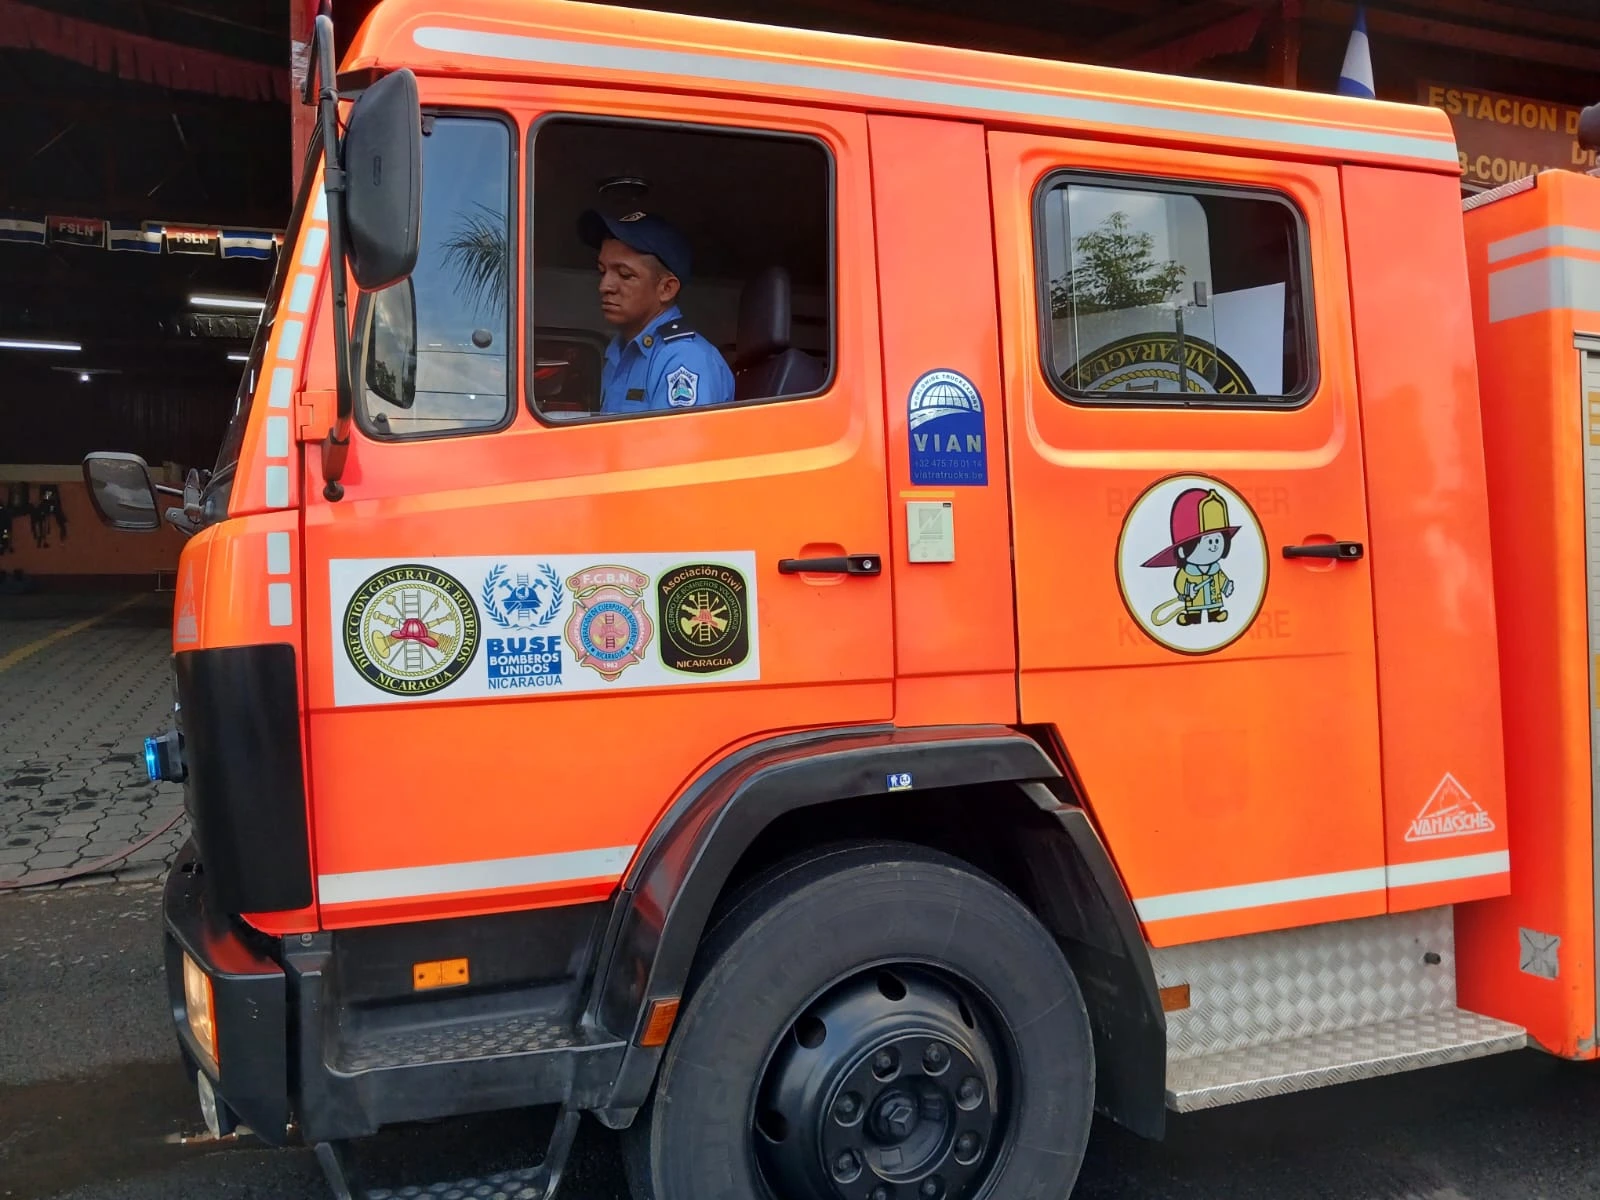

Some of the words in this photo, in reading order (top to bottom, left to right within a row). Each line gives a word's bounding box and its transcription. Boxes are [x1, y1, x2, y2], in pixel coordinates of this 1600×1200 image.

[1428, 86, 1557, 132] ESTACION
[59, 222, 94, 237] FSLN
[175, 232, 209, 245] FSLN
[913, 433, 982, 453] VIAN
[662, 566, 718, 595] Asociación
[721, 571, 743, 592] Civil
[350, 593, 371, 670] DIRECCION
[369, 570, 433, 595] GENERAL
[435, 576, 454, 593] DE
[452, 589, 475, 664] BOMBEROS
[486, 635, 562, 654] BUSF
[489, 652, 560, 667] BOMBEROS
[676, 658, 733, 669] NICARAGUA
[499, 663, 550, 676] UNIDOS
[376, 671, 453, 692] NICARAGUA
[488, 675, 563, 690] NICARAGUA
